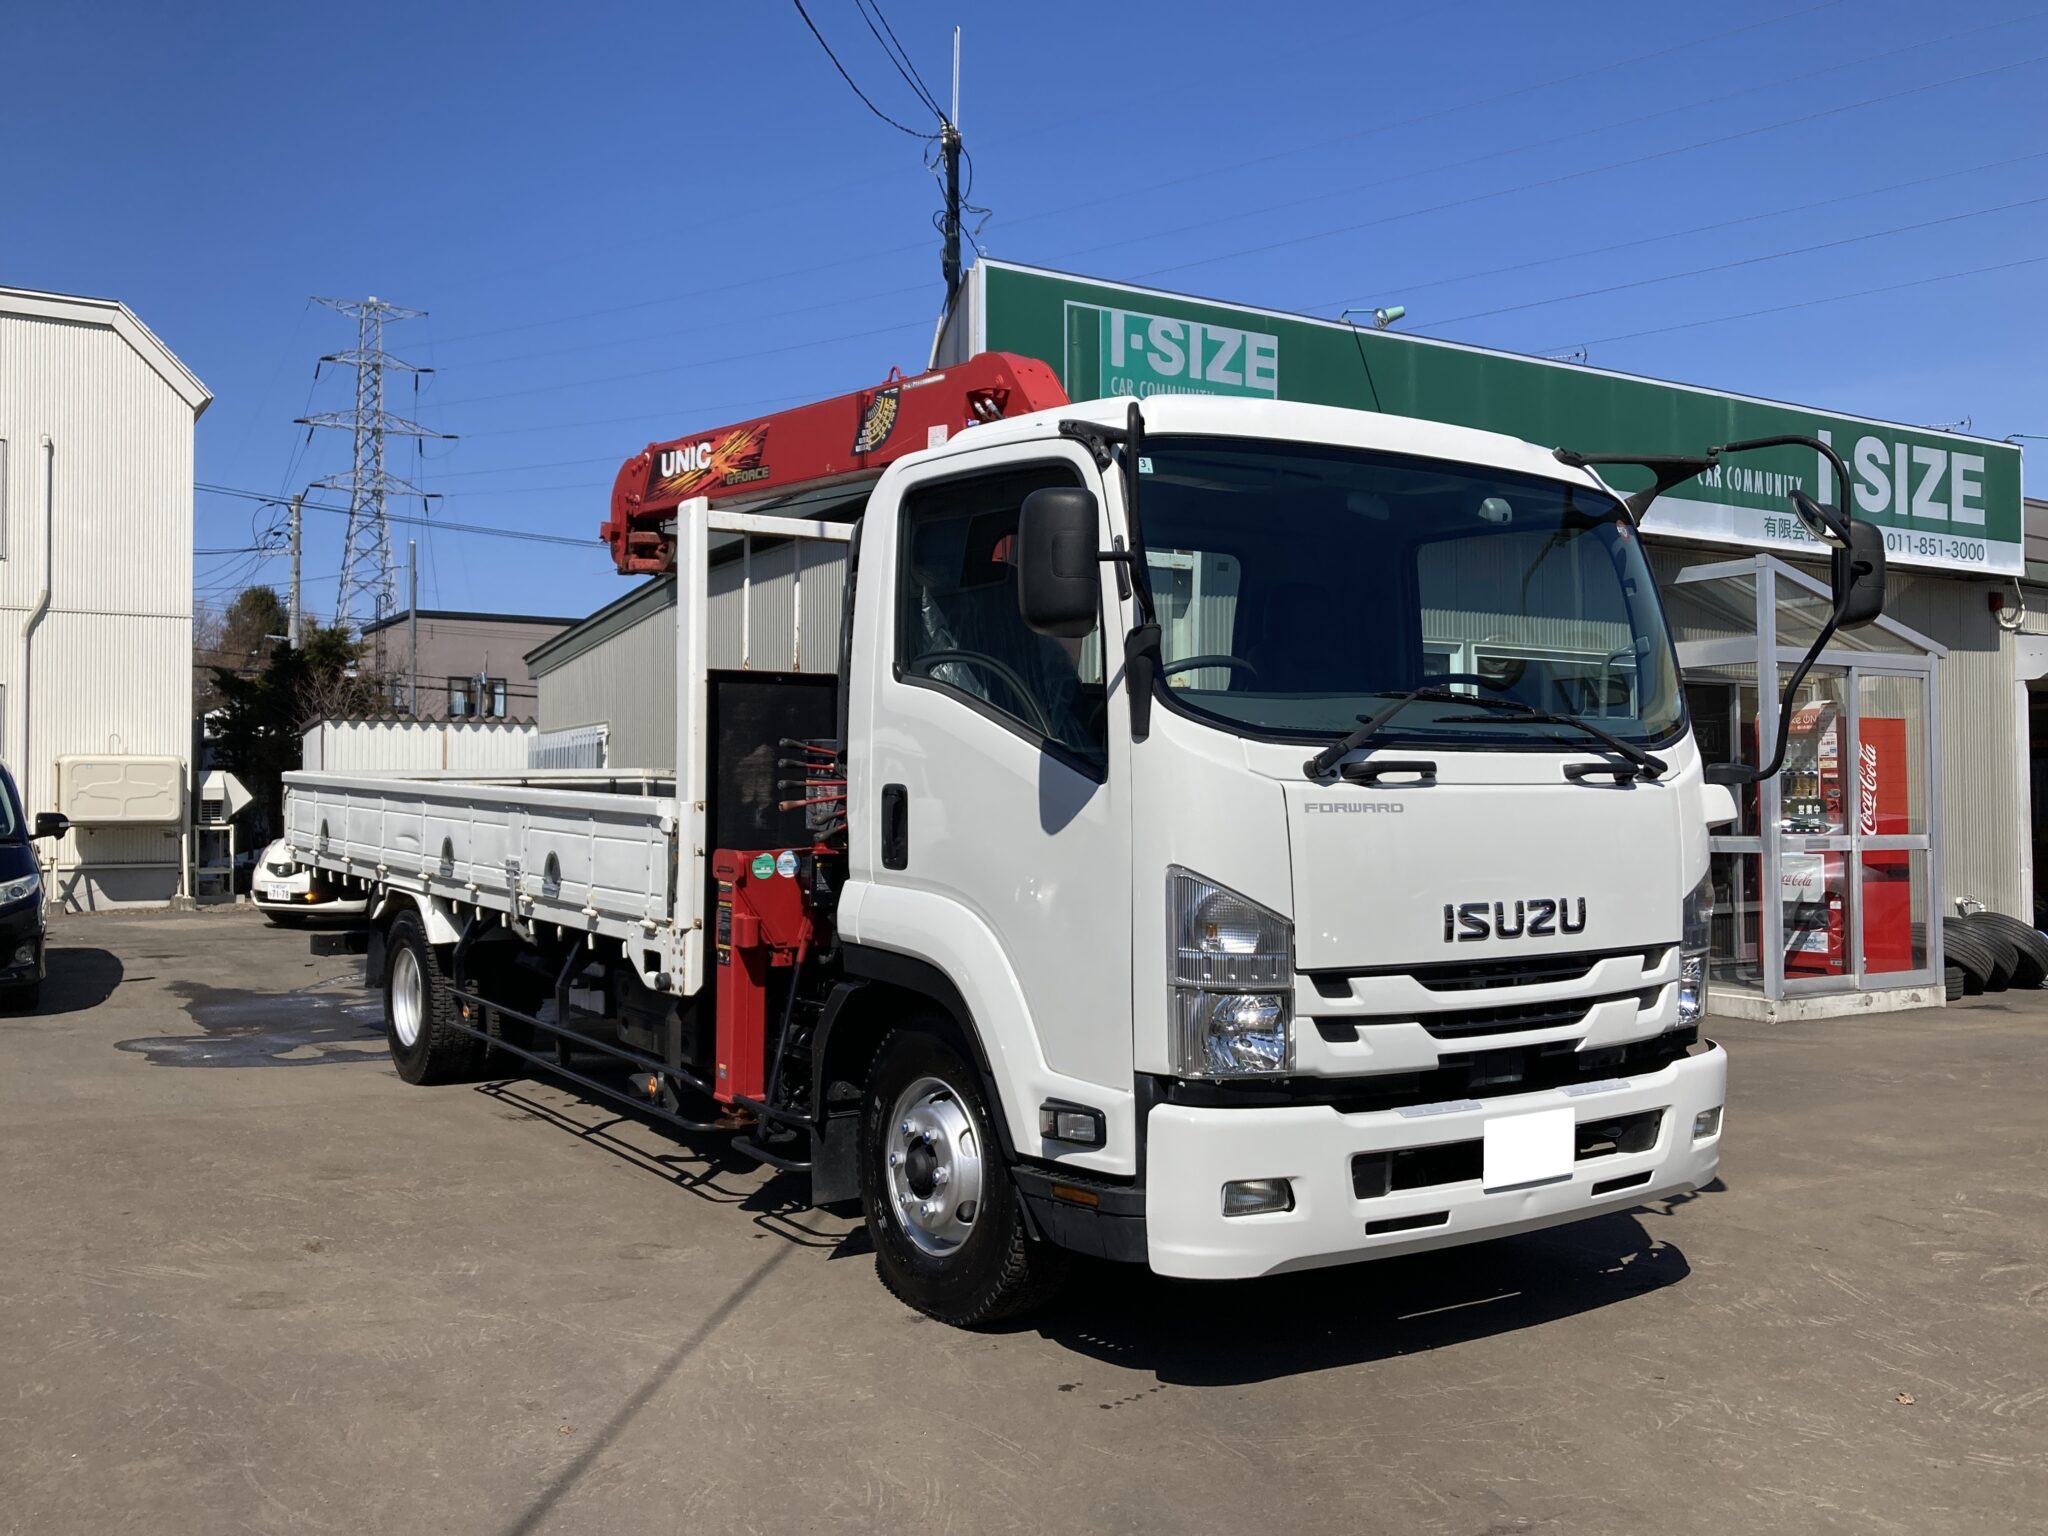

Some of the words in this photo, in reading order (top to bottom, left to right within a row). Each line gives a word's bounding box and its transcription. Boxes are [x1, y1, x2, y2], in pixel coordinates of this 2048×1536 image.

[1111, 376, 1134, 396] CAR
[661, 442, 712, 477] UNIC
[1726, 466, 1802, 498] COMMUNITY
[1887, 532, 1985, 561] 011-851-3000
[1304, 803, 1405, 814] FORWARD
[1444, 897, 1586, 943] ISUZU
